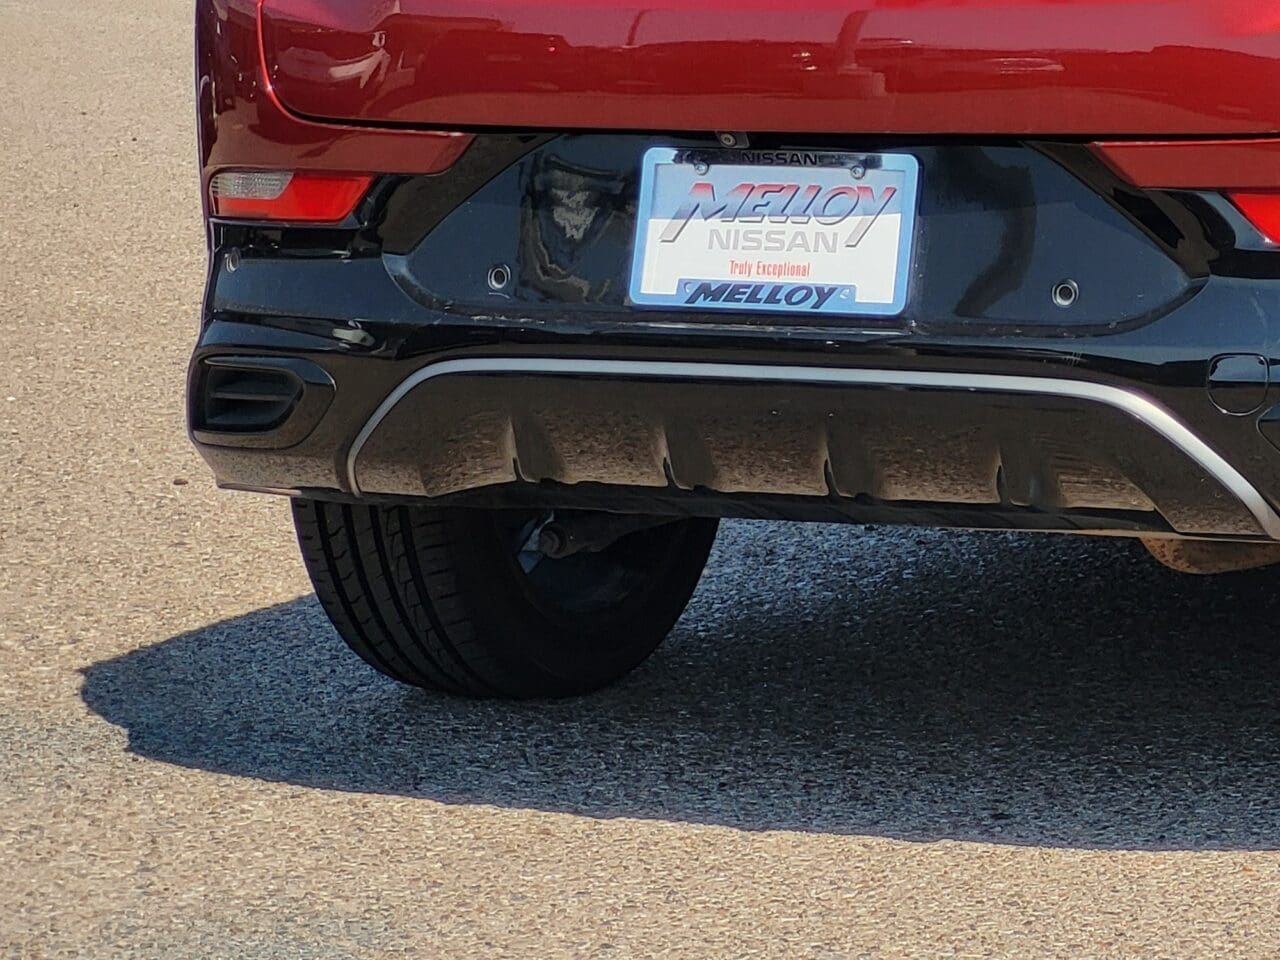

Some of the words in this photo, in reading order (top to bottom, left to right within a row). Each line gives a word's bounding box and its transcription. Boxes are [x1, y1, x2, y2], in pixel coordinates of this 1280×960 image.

[741, 150, 819, 167] NISSAN
[659, 182, 897, 248] MELLOY
[707, 227, 838, 253] NISSAN
[729, 259, 752, 278] Truly
[756, 260, 811, 278] Exceptional
[684, 281, 838, 310] MELLOY
